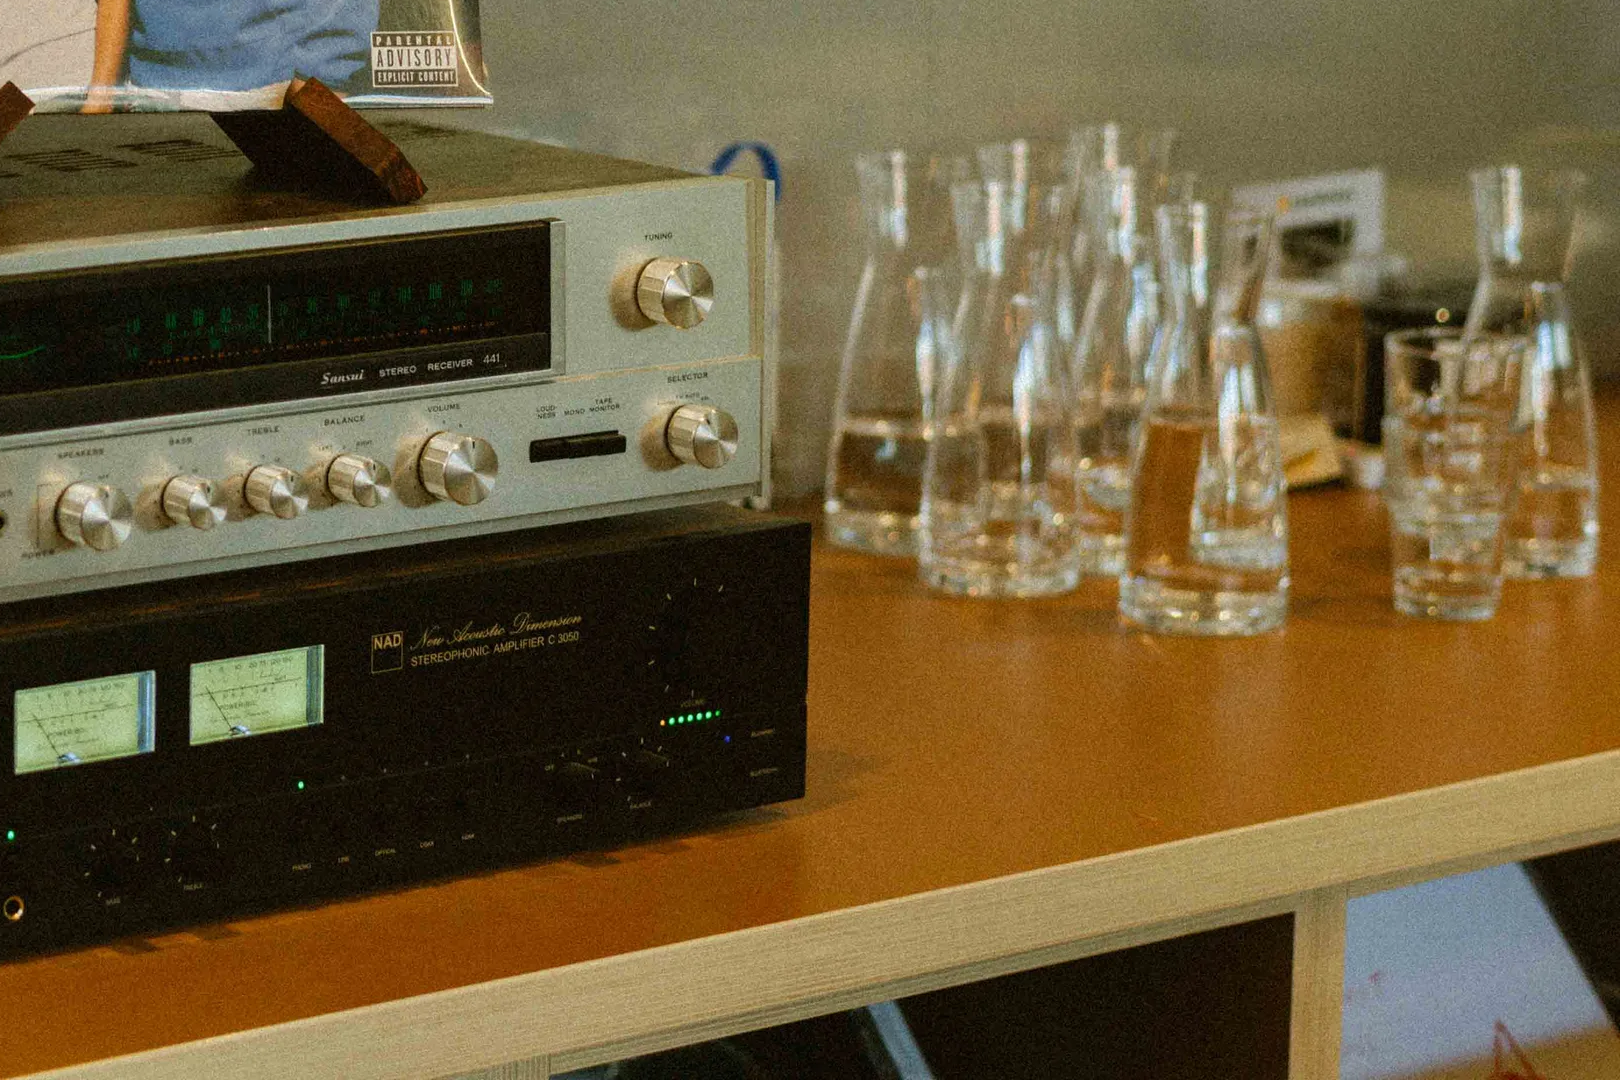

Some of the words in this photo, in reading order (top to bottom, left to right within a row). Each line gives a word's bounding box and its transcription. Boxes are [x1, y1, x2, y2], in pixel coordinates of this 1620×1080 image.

[375, 35, 452, 47] PARENTAL
[377, 48, 452, 68] ADVISORY
[377, 71, 415, 83] EXPLICIT
[418, 70, 455, 82] CONTENT
[644, 232, 673, 241] TUNING
[320, 369, 365, 385] Sansui
[379, 365, 417, 378] STEREO
[427, 358, 473, 372] RECEIVER
[483, 353, 500, 364] 441
[667, 371, 708, 383] SELECTOR
[594, 397, 613, 406] TAPE
[427, 403, 461, 413] VOLUME
[564, 407, 585, 417] MONO
[589, 403, 620, 413] MONITOR
[324, 415, 365, 426] BALANCE
[247, 425, 280, 435] TREBLE
[168, 436, 192, 446] BASS
[57, 447, 104, 459] SPEAKERS
[373, 634, 402, 650] NAD
[409, 624, 443, 651] New
[446, 620, 506, 644] Acoustic
[510, 611, 583, 634] Dimension
[410, 647, 489, 667] STEREOPHONIC
[493, 637, 544, 654] AMPLIFIER
[548, 635, 555, 645] C
[557, 631, 580, 644] 3050
